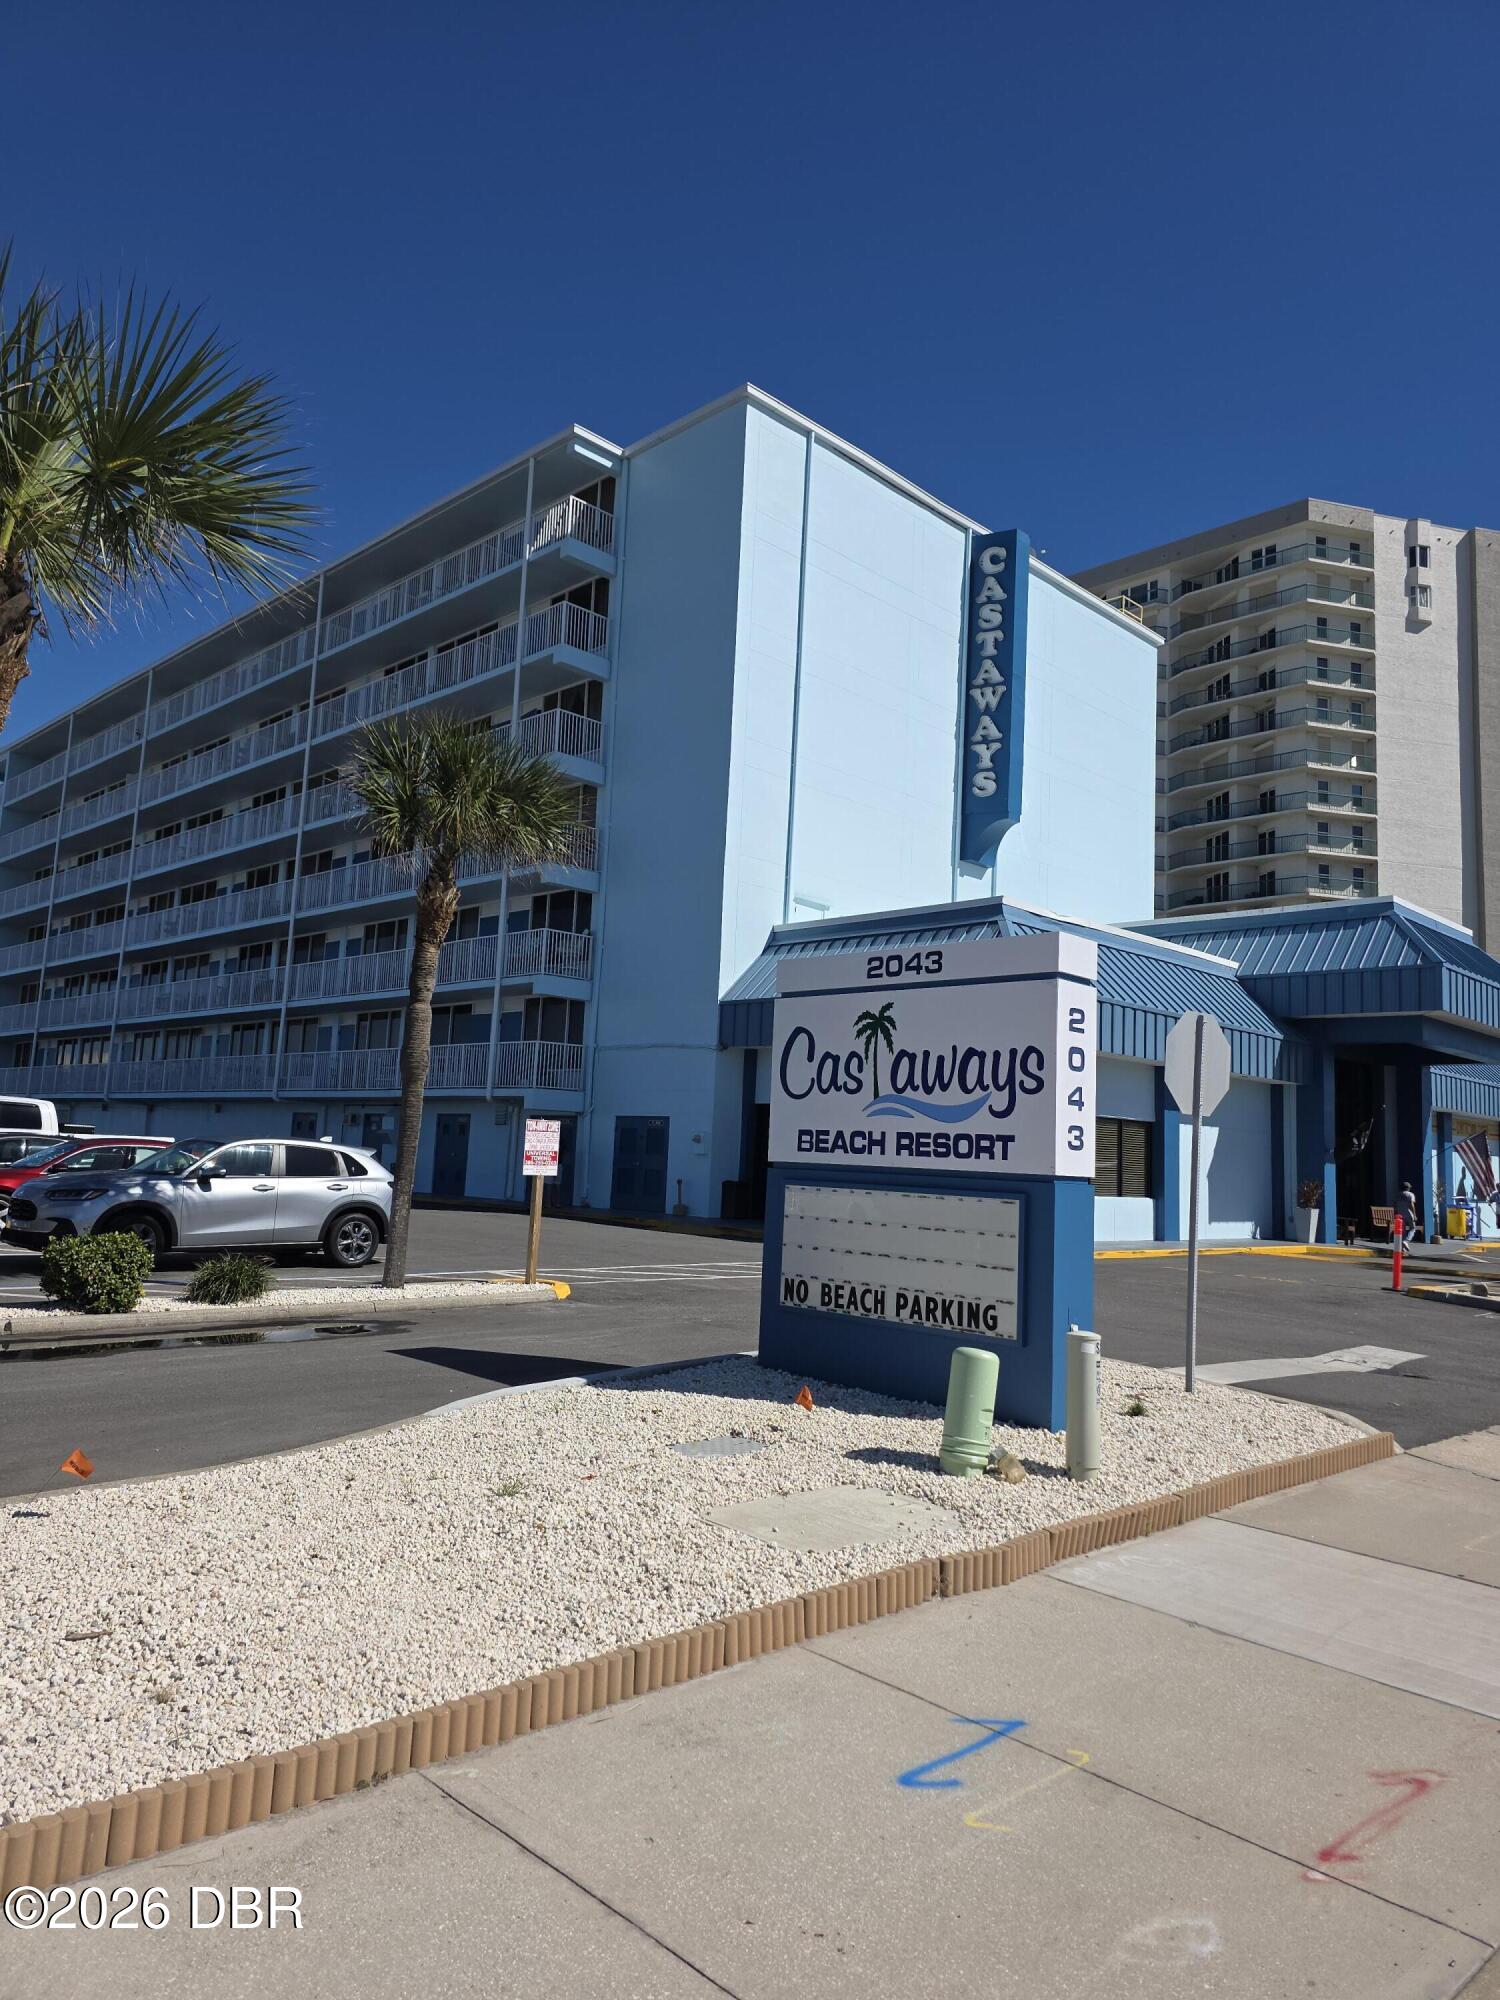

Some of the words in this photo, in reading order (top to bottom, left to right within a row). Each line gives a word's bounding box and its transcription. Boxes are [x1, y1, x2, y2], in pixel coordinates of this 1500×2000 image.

[968, 546, 1007, 798] CASTAWAYS
[866, 950, 943, 979] 2043
[1067, 1007, 1085, 1152] 2043
[797, 1129, 886, 1156] BEACH
[895, 1131, 1016, 1160] RESORT
[783, 1277, 809, 1304] NO
[820, 1283, 886, 1315] BEACH
[895, 1292, 998, 1332] PARKING
